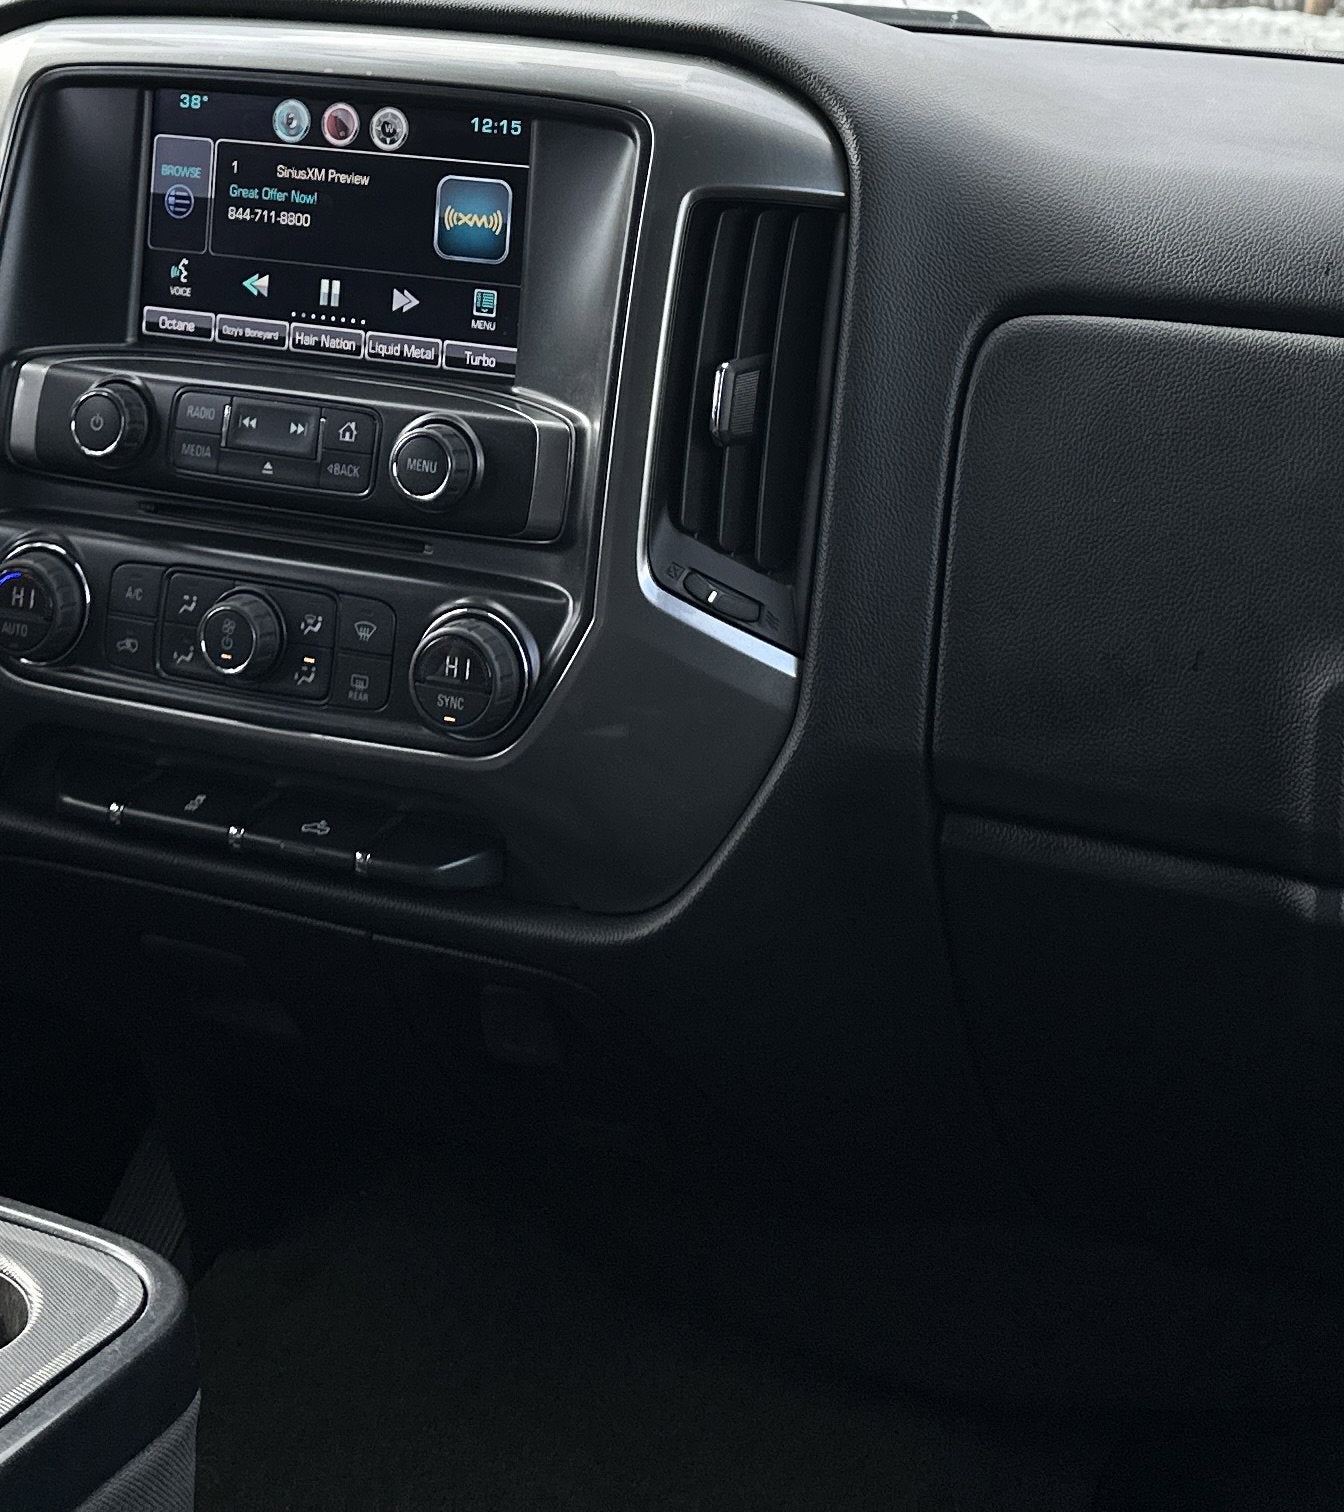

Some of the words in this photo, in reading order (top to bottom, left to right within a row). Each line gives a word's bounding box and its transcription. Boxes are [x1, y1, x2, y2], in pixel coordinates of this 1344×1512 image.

[179, 93, 208, 109] 38°
[470, 117, 522, 136] 12:15
[161, 164, 202, 179] BROWSE
[231, 160, 239, 174] 1
[276, 164, 325, 182] SiriusXM
[327, 168, 371, 186] Preview
[229, 183, 259, 199] Great
[261, 187, 288, 202] Offer
[291, 190, 318, 205] Now!
[227, 206, 312, 227] 844-711-8800
[169, 286, 192, 298] VOICE
[158, 315, 196, 333] Octane
[222, 324, 244, 338] Ozzy's
[244, 328, 279, 341] Boneyard
[471, 319, 496, 332] MENU
[295, 331, 319, 347] Hair
[320, 335, 357, 352] Nation
[368, 340, 401, 357] Liquid
[403, 344, 436, 361] Metal
[464, 351, 496, 368] Turbo
[186, 405, 215, 421] RADIO
[181, 443, 211, 458] MEDIA
[333, 463, 360, 478] BACK
[407, 456, 437, 474] MENU
[11, 586, 35, 609] HI
[125, 586, 143, 601] A/C
[1, 621, 28, 637] AUTO
[445, 655, 470, 680] HI
[348, 690, 369, 702] REAR
[437, 693, 465, 710] SYNC
